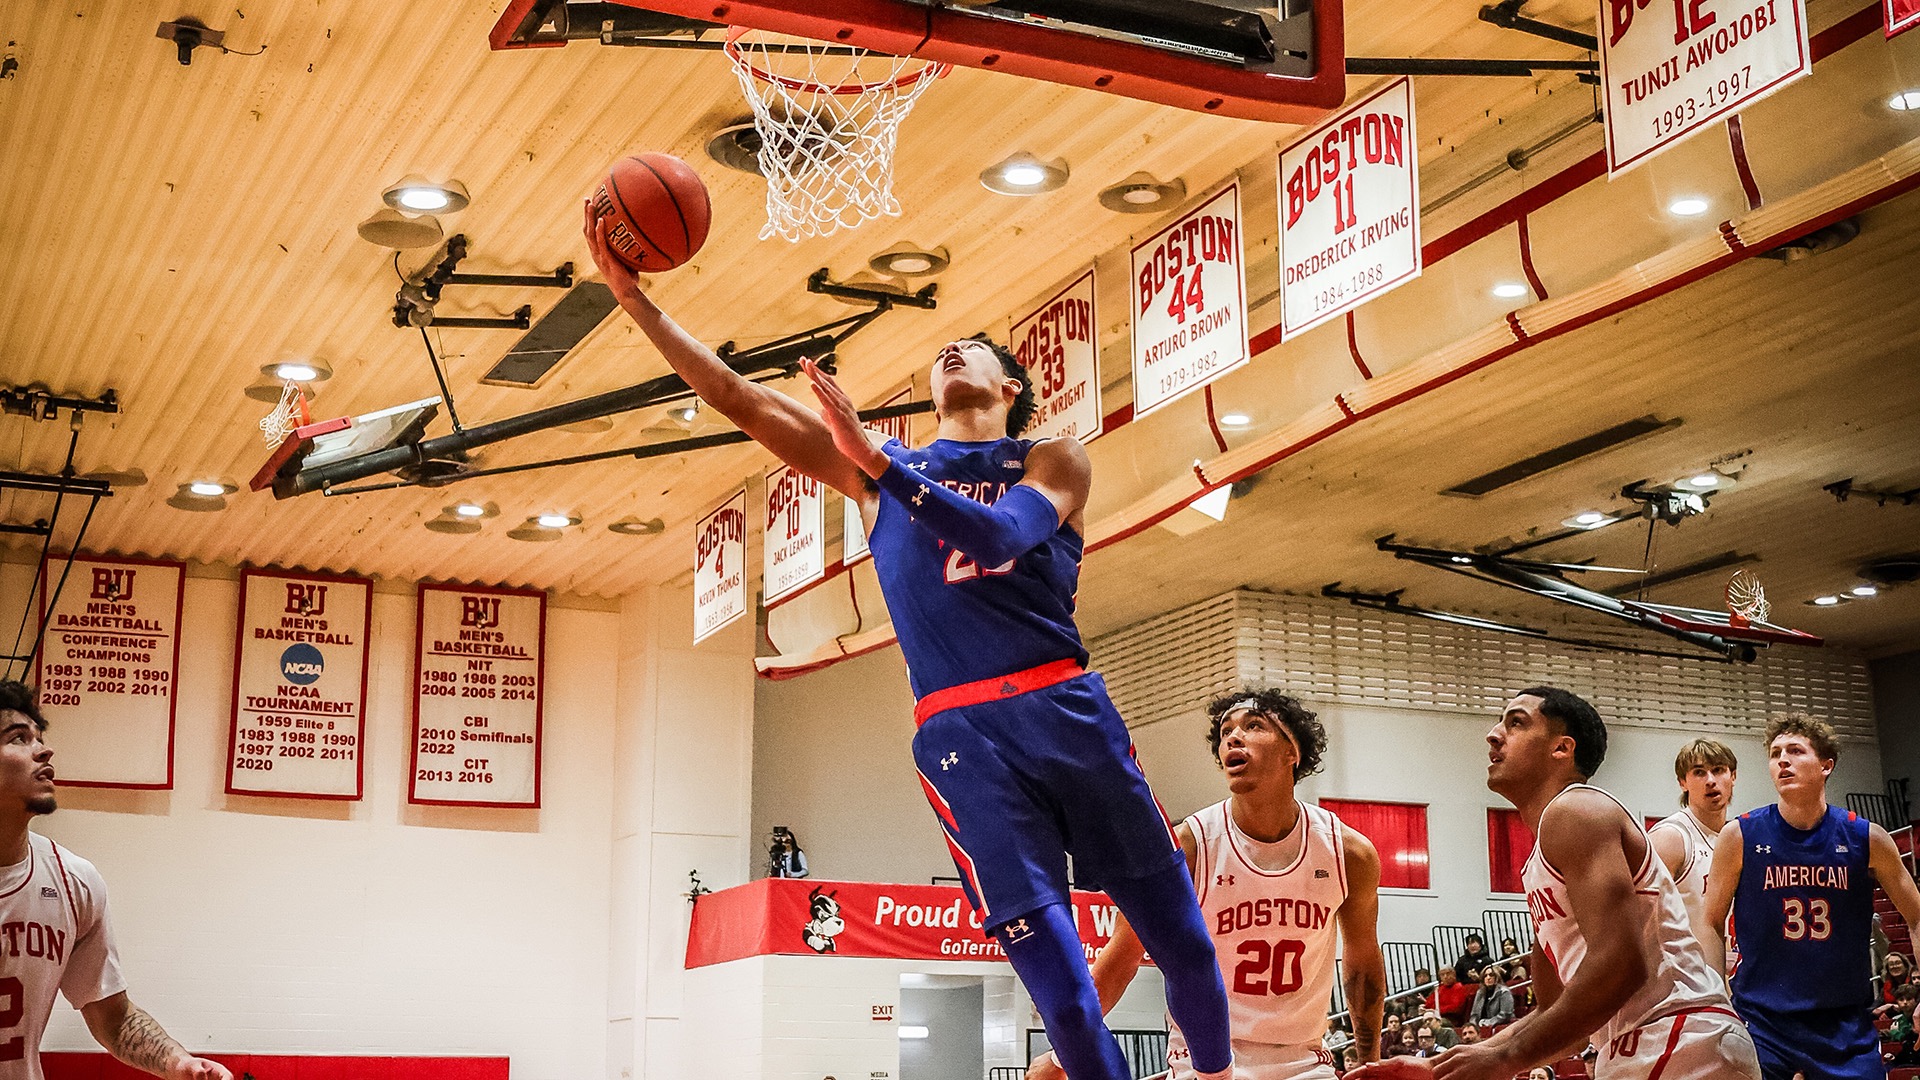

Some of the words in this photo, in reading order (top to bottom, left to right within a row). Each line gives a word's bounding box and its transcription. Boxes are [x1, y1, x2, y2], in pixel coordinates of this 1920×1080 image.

[1621, 56, 1680, 106] TUNJI
[1685, 0, 1777, 73] AWOJOBI
[1652, 65, 1752, 138] 1993-1997
[1287, 113, 1404, 231] BOSTON
[1333, 173, 1357, 235] 11
[608, 220, 649, 263] ROCK
[1286, 234, 1357, 286] DREDERICK
[1361, 206, 1409, 249] IRVING
[1139, 215, 1233, 320] BOSTON
[1167, 262, 1204, 325] 44
[1314, 263, 1383, 312] 1984-1988
[1144, 329, 1187, 368] ARTURO
[1191, 303, 1231, 342] BROWN
[1041, 344, 1065, 399] 33
[1160, 350, 1218, 394] 1979-1982
[1050, 380, 1086, 415] WRIGHT
[787, 499, 799, 540] 10
[696, 508, 743, 573] BOSTON
[773, 547, 787, 565] JACK
[790, 531, 814, 557] LEAMAN
[715, 544, 724, 579] 4
[90, 567, 136, 601] BU
[699, 587, 716, 607] KEVIN
[717, 572, 740, 596] THOMAS
[285, 583, 328, 615] BU
[87, 602, 136, 616] MEN'S
[461, 596, 501, 628] BU
[58, 614, 162, 632] BASKETBALL
[281, 617, 328, 630] MEN'S
[62, 634, 157, 649] CONFERENCE
[254, 628, 353, 645] BASKETBALL
[459, 630, 504, 643] MEN'S
[67, 649, 151, 663] CHAMPIONS
[433, 640, 528, 657] BASKETBALL
[45, 665, 83, 677] 1983
[89, 666, 126, 680] 1988
[133, 669, 169, 682] 1990
[284, 662, 322, 676] NCAA
[467, 659, 493, 672] NIT
[44, 679, 82, 692] 1997
[87, 681, 125, 694] 2002
[131, 683, 168, 696] 2011
[422, 670, 457, 683] 1980
[462, 672, 497, 685] 1986
[502, 674, 536, 687] 2003
[42, 693, 80, 706] 2020
[277, 685, 320, 699] NCAA
[421, 684, 456, 697] 2004
[461, 686, 496, 699] 2005
[501, 688, 536, 700] 2014
[246, 696, 354, 713] TOURNAMENT
[256, 715, 292, 728] 1959
[295, 719, 324, 730] Elite
[327, 721, 335, 731] 8
[463, 716, 489, 728] CBI
[239, 729, 274, 742] 1983
[280, 732, 315, 744] 1988
[322, 734, 356, 747] 1990
[420, 728, 456, 741] 2010
[460, 730, 534, 744] Semifinals
[237, 743, 274, 756] 1997
[278, 746, 315, 759] 2002
[320, 748, 355, 760] 2011
[420, 742, 455, 755] 2022
[236, 757, 273, 771] 2020
[463, 758, 489, 770] CIT
[417, 770, 453, 782] 2013
[458, 771, 493, 784] 2016
[1763, 865, 1849, 891] AMERICAN
[874, 896, 961, 929] Proud
[1216, 898, 1331, 935] BOSTON
[1783, 897, 1832, 941] 33
[0, 921, 65, 966] TON
[940, 937, 1007, 956] GoTerrie
[1233, 938, 1306, 997] 20
[872, 1005, 894, 1015] EXIT
